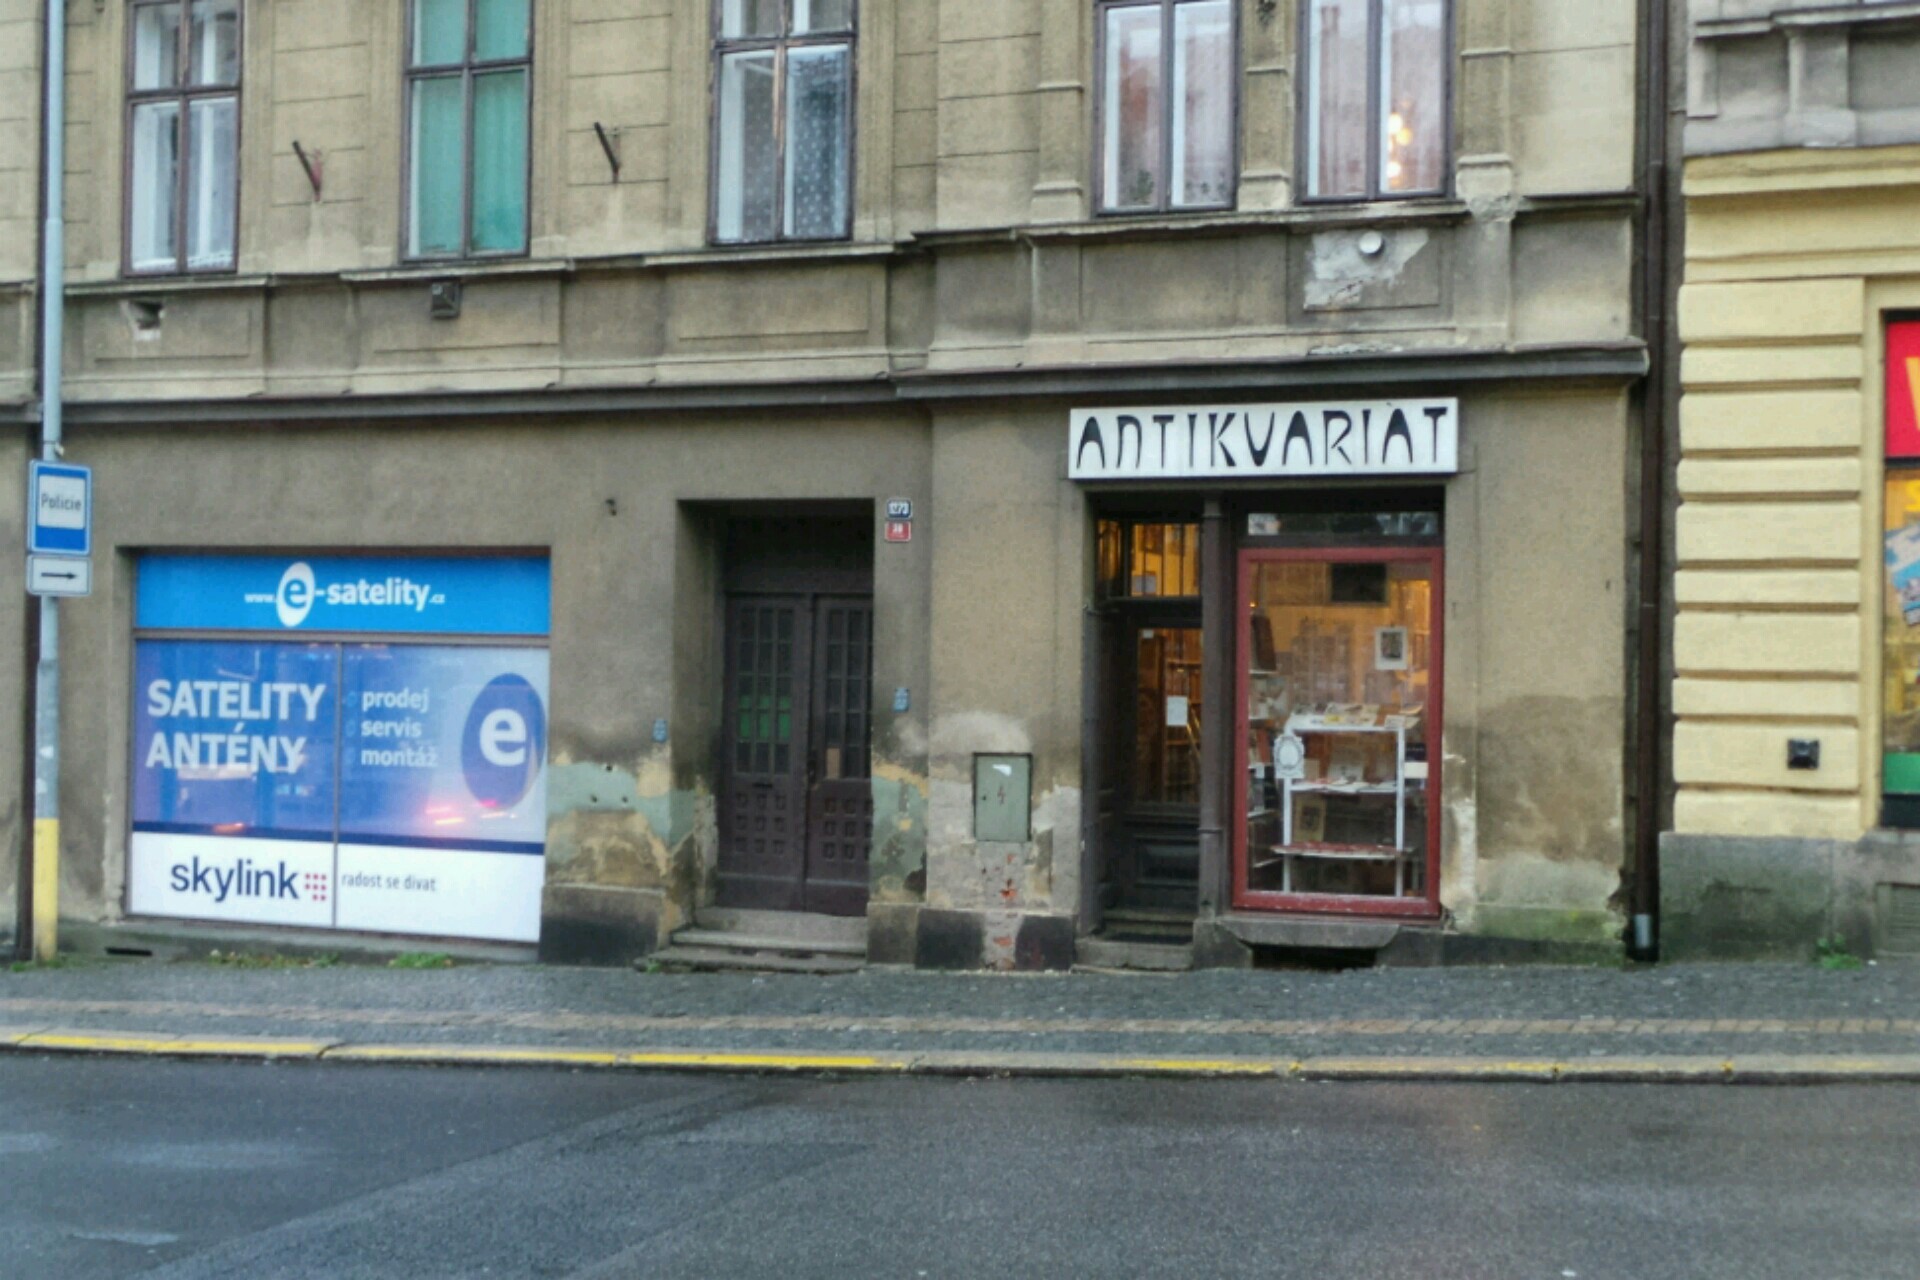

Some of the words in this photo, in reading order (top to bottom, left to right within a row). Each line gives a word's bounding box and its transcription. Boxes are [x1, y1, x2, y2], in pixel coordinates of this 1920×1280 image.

[1077, 407, 1448, 468] ANTIKVARIAT
[40, 493, 82, 511] Policie
[148, 678, 326, 720] SATELITY
[362, 688, 429, 713] prodej
[361, 717, 422, 737] servis
[146, 722, 306, 773] ANTÉNY
[361, 746, 438, 767] montáž
[170, 856, 299, 902] skylink
[341, 872, 382, 888] radost
[386, 877, 400, 889] se
